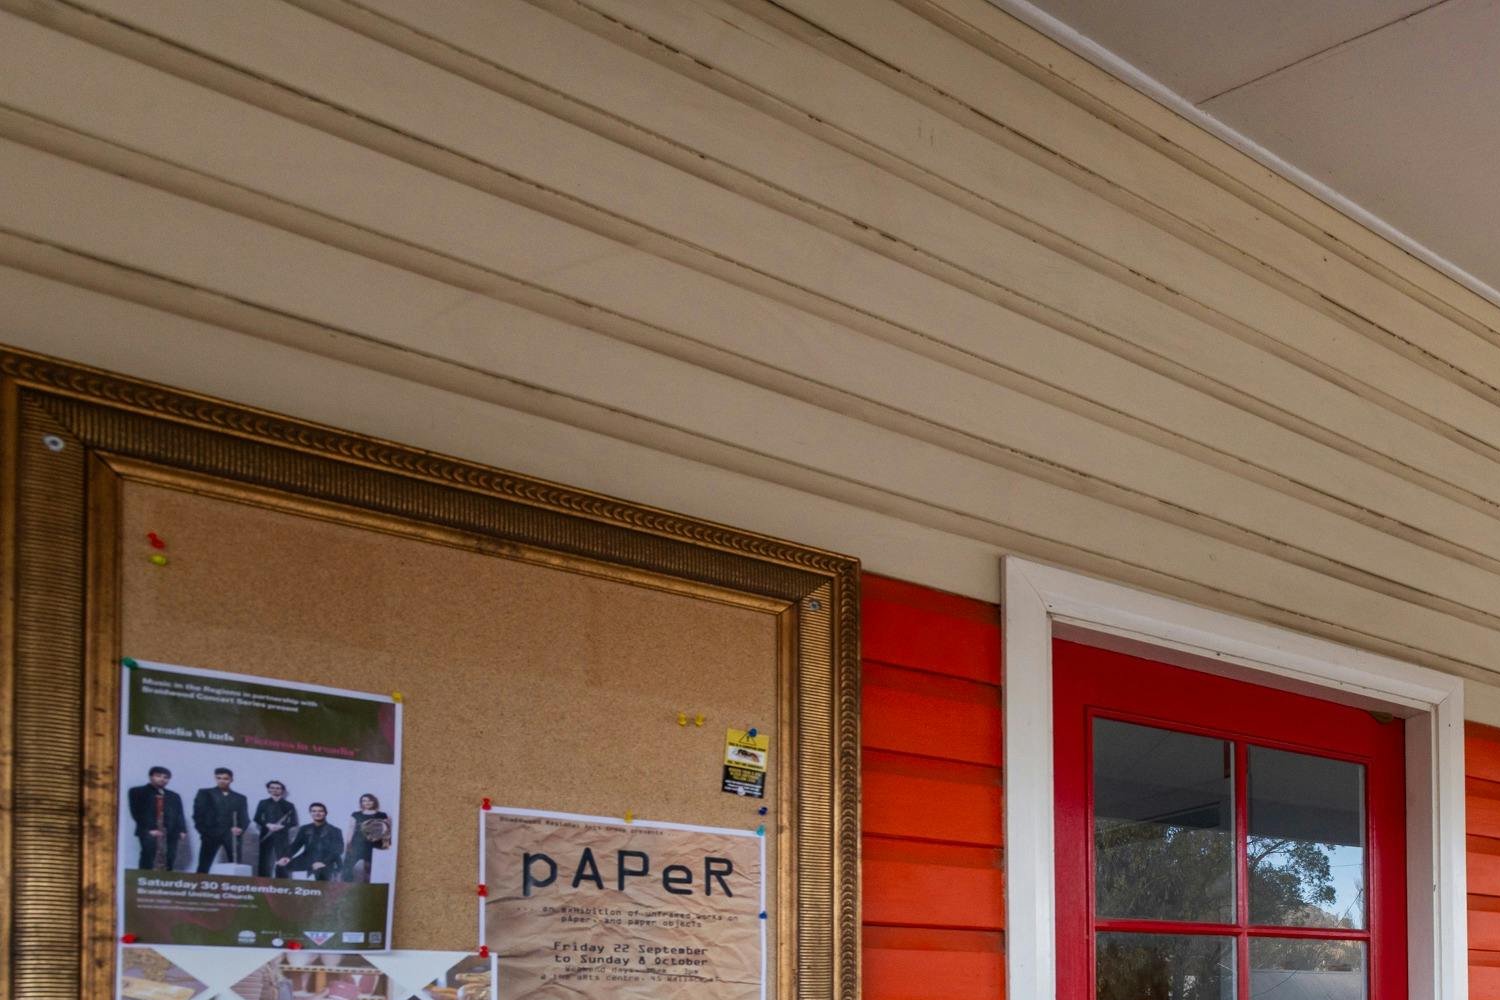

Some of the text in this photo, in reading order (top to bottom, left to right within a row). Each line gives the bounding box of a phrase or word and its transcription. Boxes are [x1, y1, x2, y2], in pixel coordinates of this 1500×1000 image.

[137, 877, 197, 891] Saturday
[200, 880, 218, 891] 30
[294, 886, 322, 897] 2pm
[553, 941, 709, 958] Friday 22 September
[555, 954, 571, 964] to
[579, 953, 633, 967] Sunday
[654, 956, 709, 967] October
